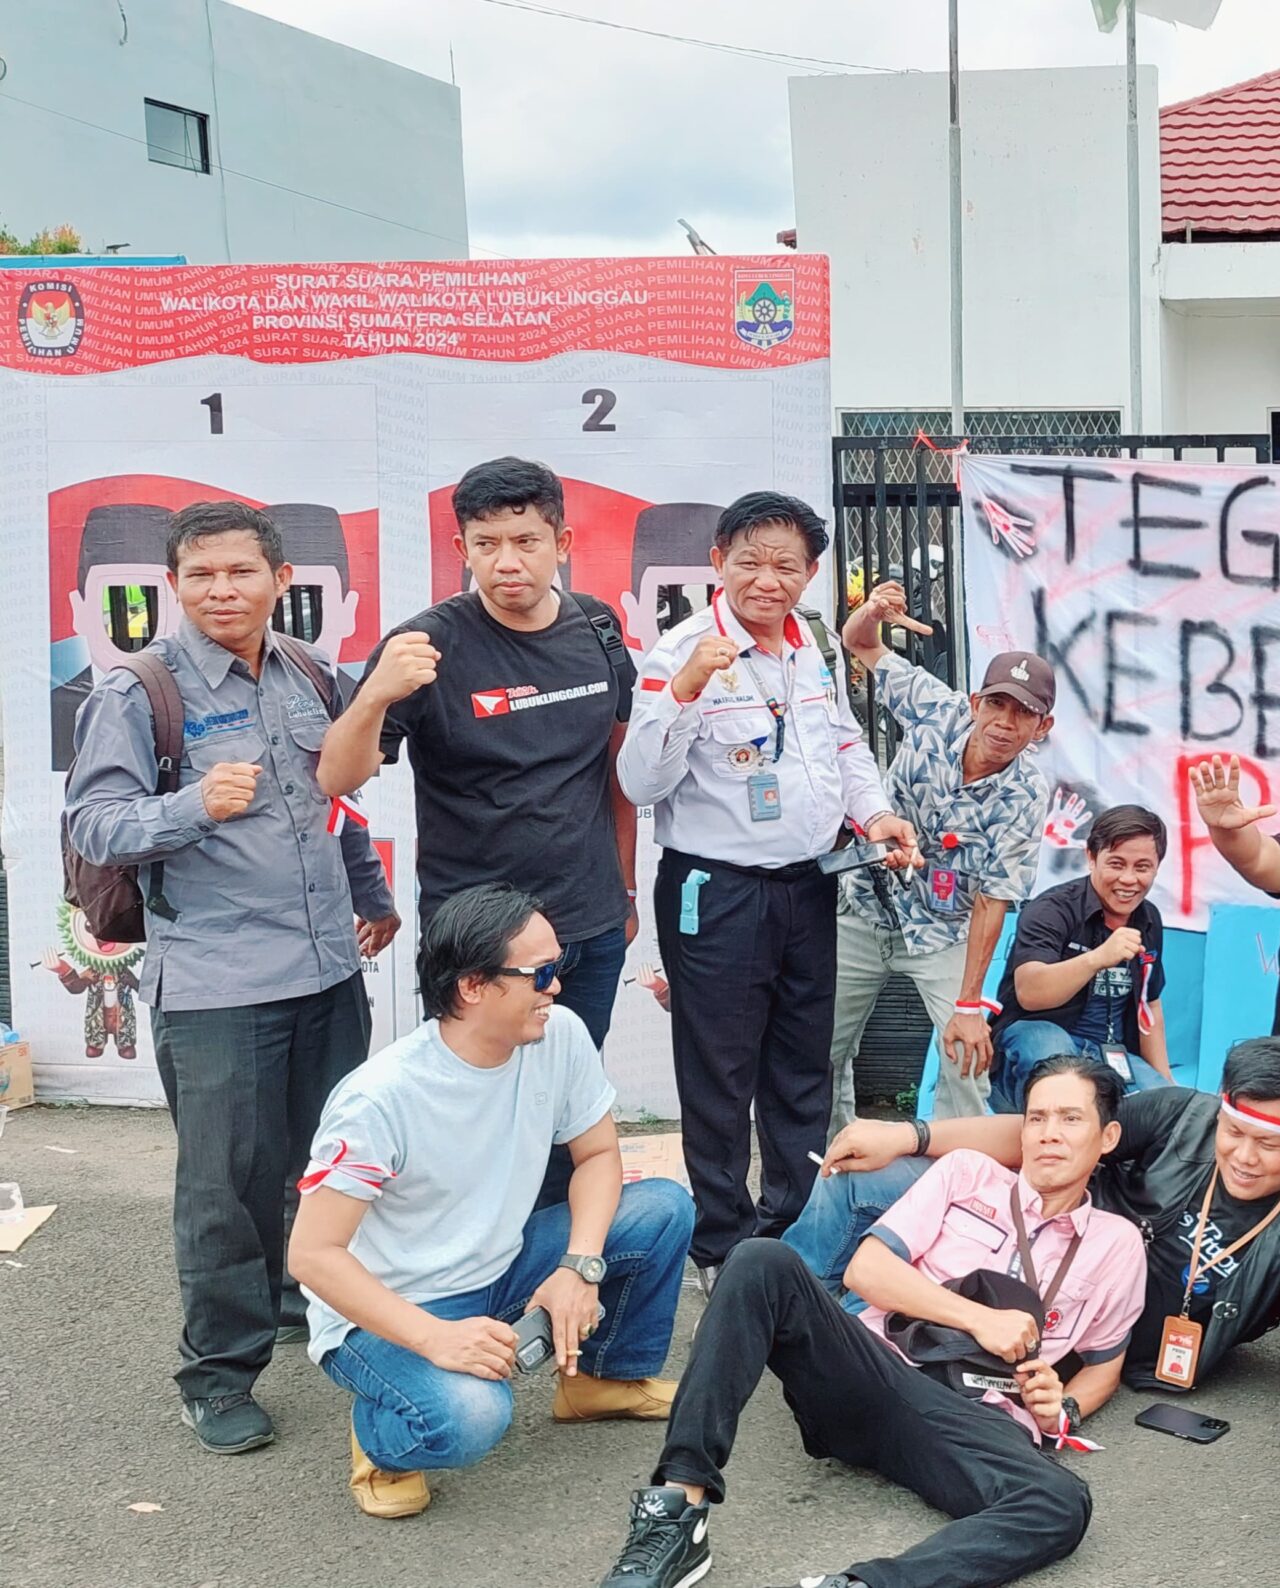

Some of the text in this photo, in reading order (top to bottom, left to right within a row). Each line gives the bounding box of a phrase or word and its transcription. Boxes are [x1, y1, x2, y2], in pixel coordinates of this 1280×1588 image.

[647, 259, 726, 272] PEMILIHAN
[134, 276, 173, 287] UMUM
[276, 271, 527, 290] SURAT SUARA PEMILIHAN
[549, 263, 592, 287] SURAT
[594, 264, 645, 283] SUARA
[647, 274, 726, 287] PEMILIHAN
[29, 282, 72, 292] KOMISI
[175, 275, 217, 296] TAHUN
[218, 278, 248, 294] 2024
[161, 290, 648, 311] WALIKOTA DAN WAKIL WALIKOTA LUBUKLINGGAU
[647, 289, 726, 303] PEMILIHAN
[135, 320, 174, 330] UMUM
[252, 311, 551, 329] PROVINSI SUMATERA SELATAN
[594, 309, 645, 328] SUARA
[647, 304, 726, 318] PEMILIHAN
[18, 318, 85, 356] PEMILIHAN UMUM
[136, 334, 175, 345] UMUM
[176, 320, 218, 341] TAHUN
[219, 321, 249, 338] 2024
[343, 332, 459, 348] TAHUN 2024
[471, 327, 548, 344] TAHUN 2024
[549, 322, 592, 347] SURAT
[594, 323, 645, 344] SUARA
[647, 319, 726, 333] PEMILIHAN
[647, 334, 726, 348] PEMILIHAN
[136, 348, 175, 360] UMUM
[176, 334, 219, 355] TAHUN
[220, 336, 250, 353] 2024
[253, 332, 298, 343] SURAT
[253, 347, 298, 358] SURAT
[471, 341, 548, 358] TAHUN 2024
[200, 393, 224, 434] 1
[581, 388, 617, 432] 2
[509, 681, 609, 711] LUBUKLINGGAU.COM
